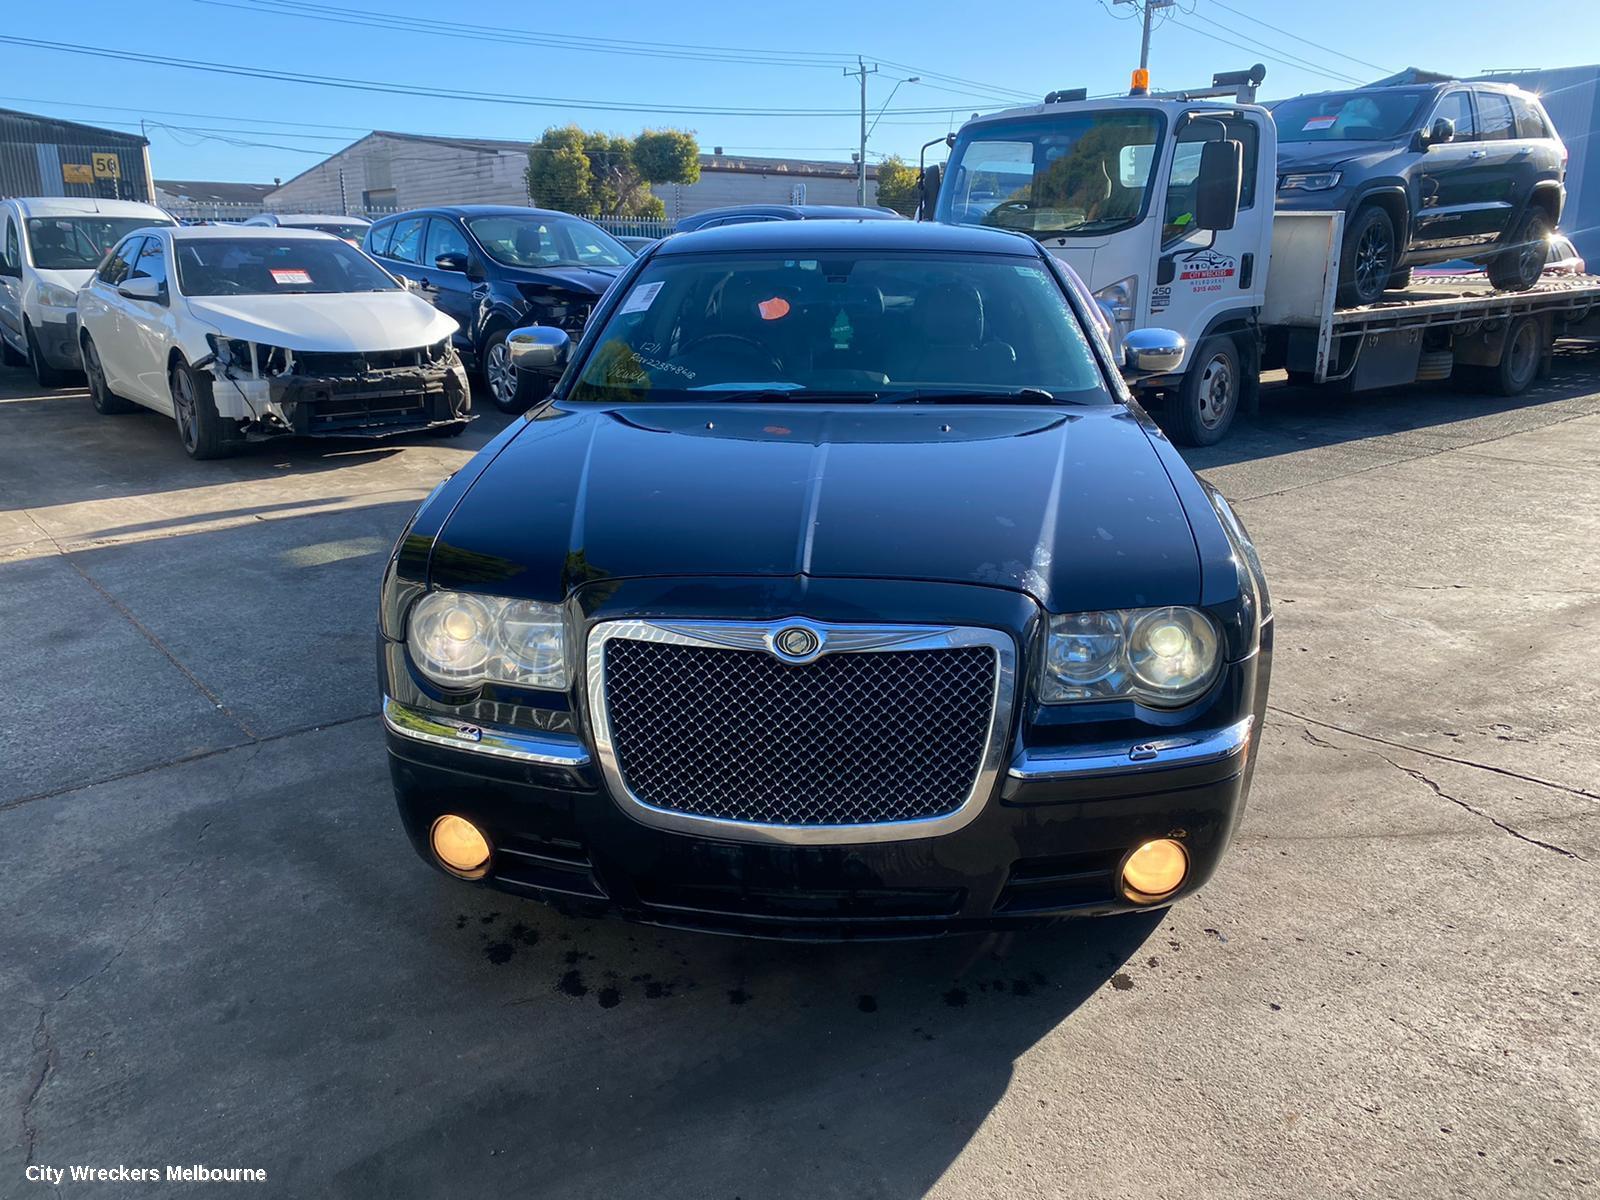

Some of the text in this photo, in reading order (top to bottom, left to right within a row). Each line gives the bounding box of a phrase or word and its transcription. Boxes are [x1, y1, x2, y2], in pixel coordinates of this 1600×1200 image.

[1189, 269, 1227, 279] CITY WRECKERS
[1152, 287, 1171, 295] 450
